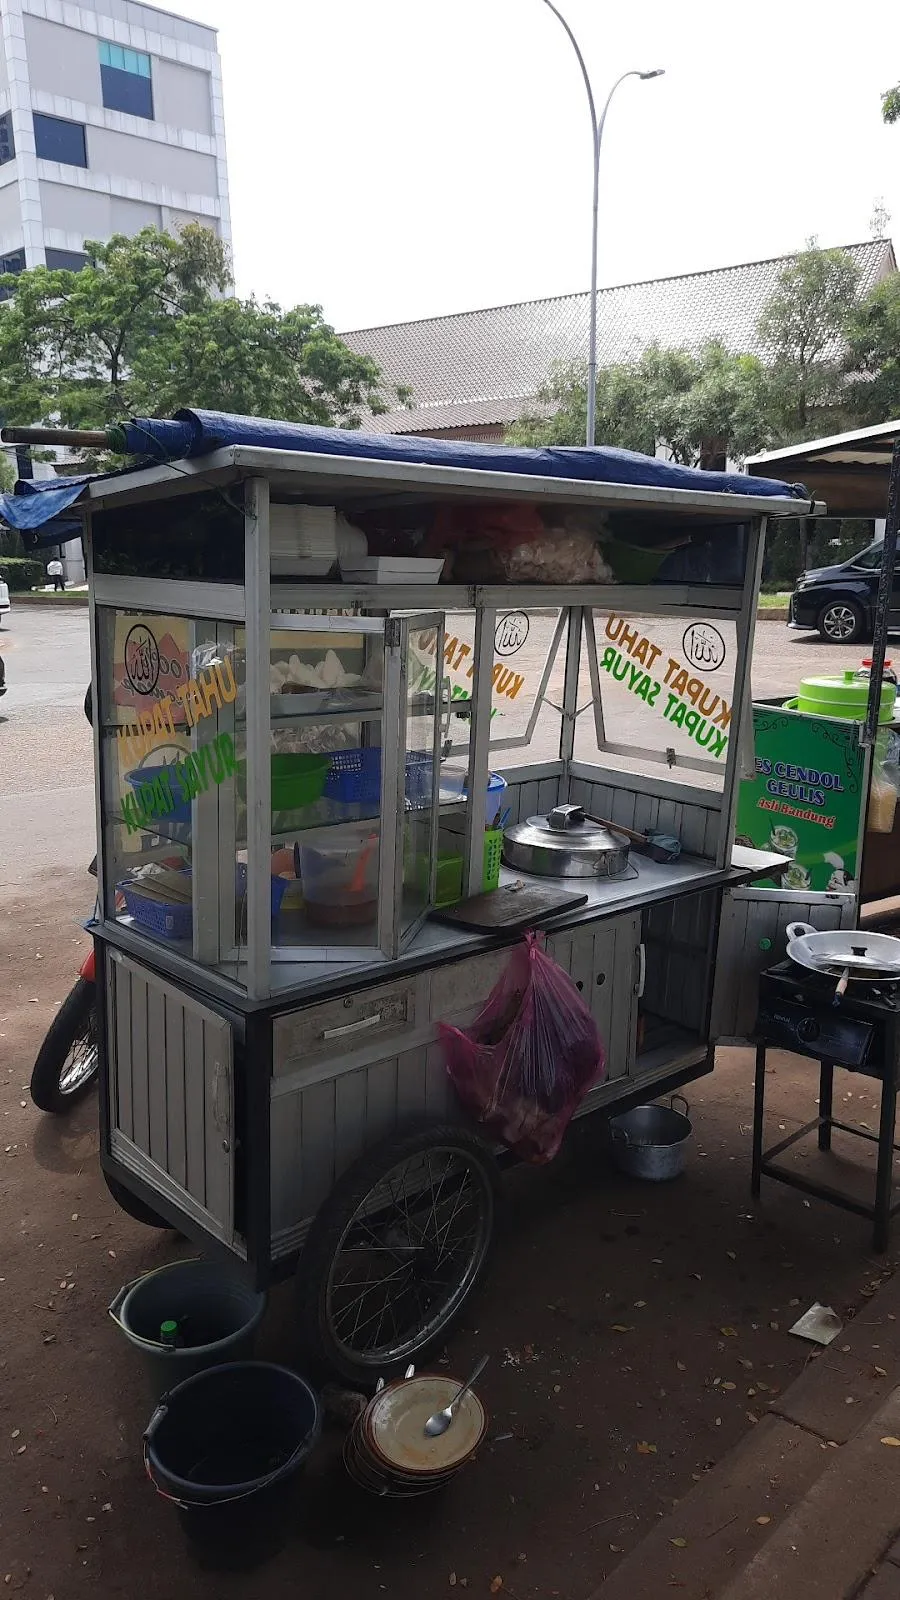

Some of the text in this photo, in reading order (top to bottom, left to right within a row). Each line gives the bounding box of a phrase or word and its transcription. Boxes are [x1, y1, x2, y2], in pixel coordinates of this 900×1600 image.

[116, 655, 238, 768] KUPAT TAHU
[119, 732, 238, 835] KUPAT SAYUR
[754, 757, 844, 792] ES CENDOL
[767, 779, 825, 807] GEULIS
[779, 802, 836, 829] Bandung
